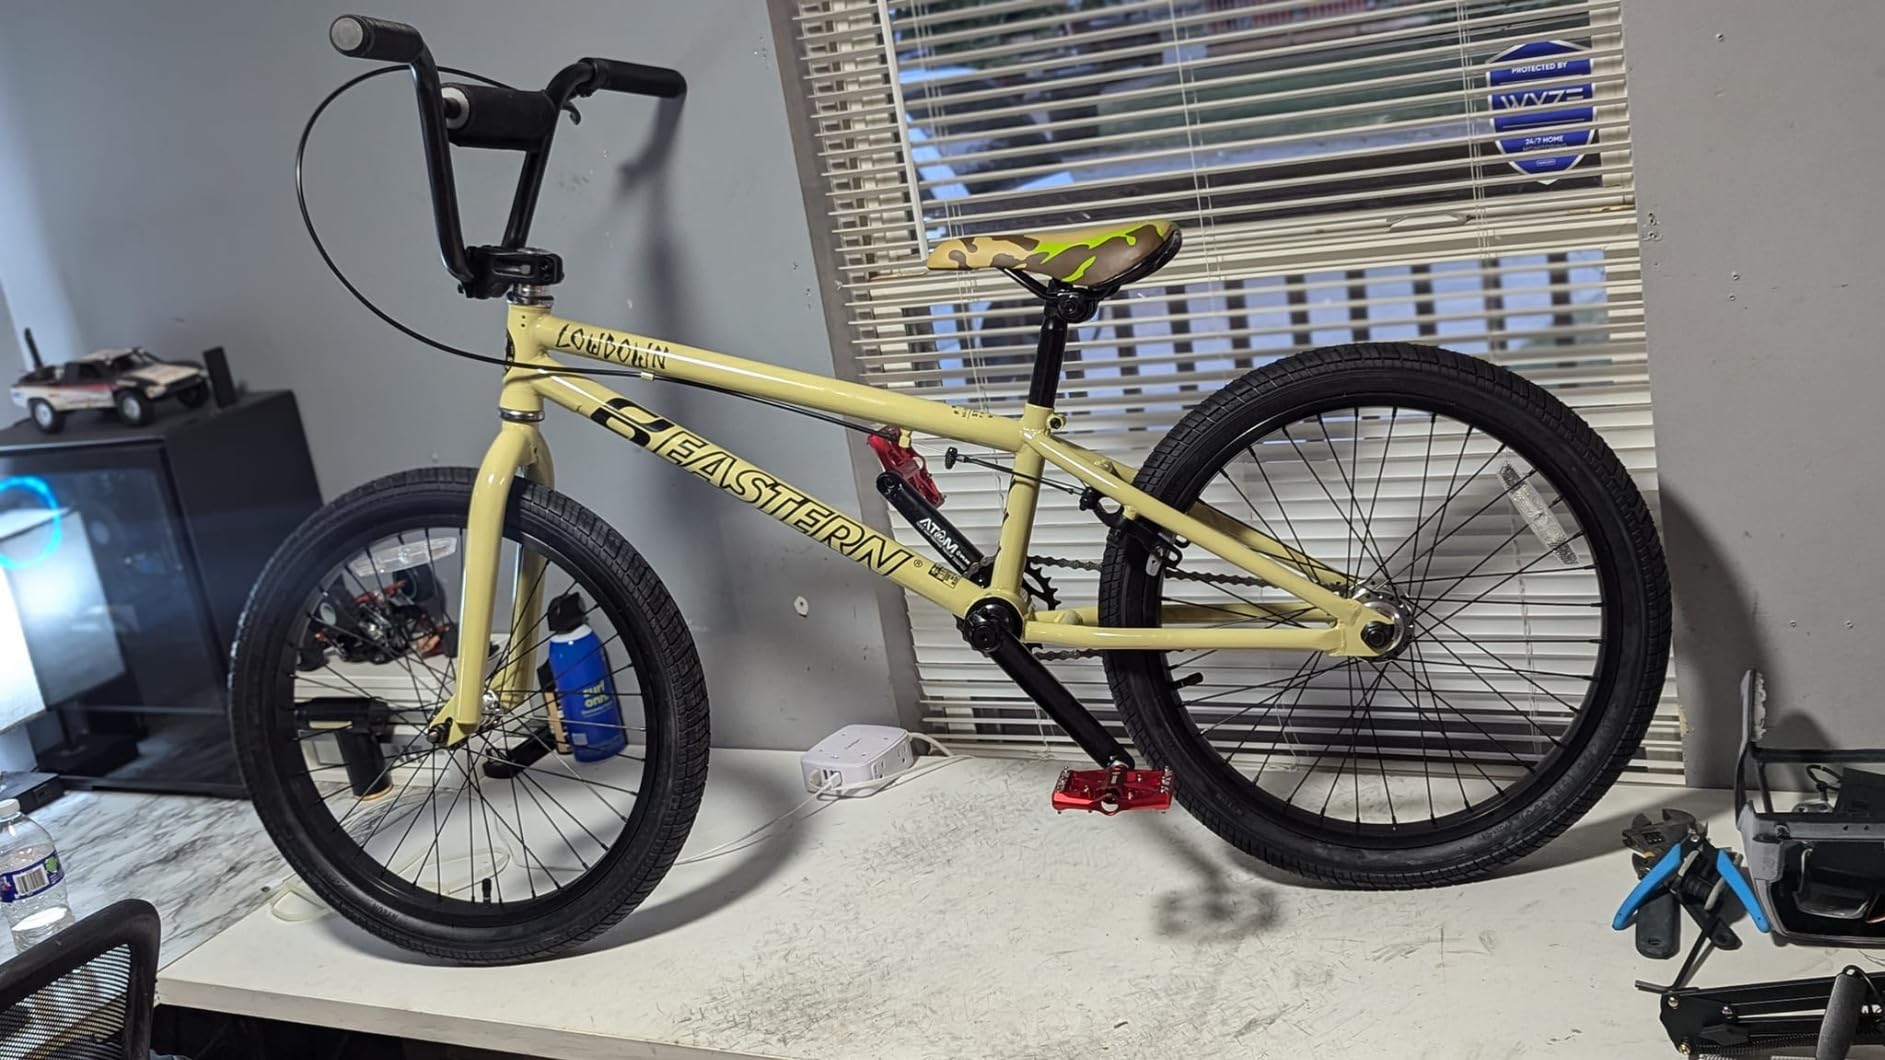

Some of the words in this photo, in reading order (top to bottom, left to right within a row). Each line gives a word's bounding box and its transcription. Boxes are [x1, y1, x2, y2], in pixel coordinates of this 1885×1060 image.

[1511, 63, 1556, 74] PROTECTED
[1557, 61, 1568, 69] BY
[1525, 137, 1541, 146] 24/7
[1542, 135, 1564, 144] HOME
[556, 323, 669, 369] LOWDOWN
[651, 430, 914, 577] EASTERN
[919, 517, 959, 553] ATOM
